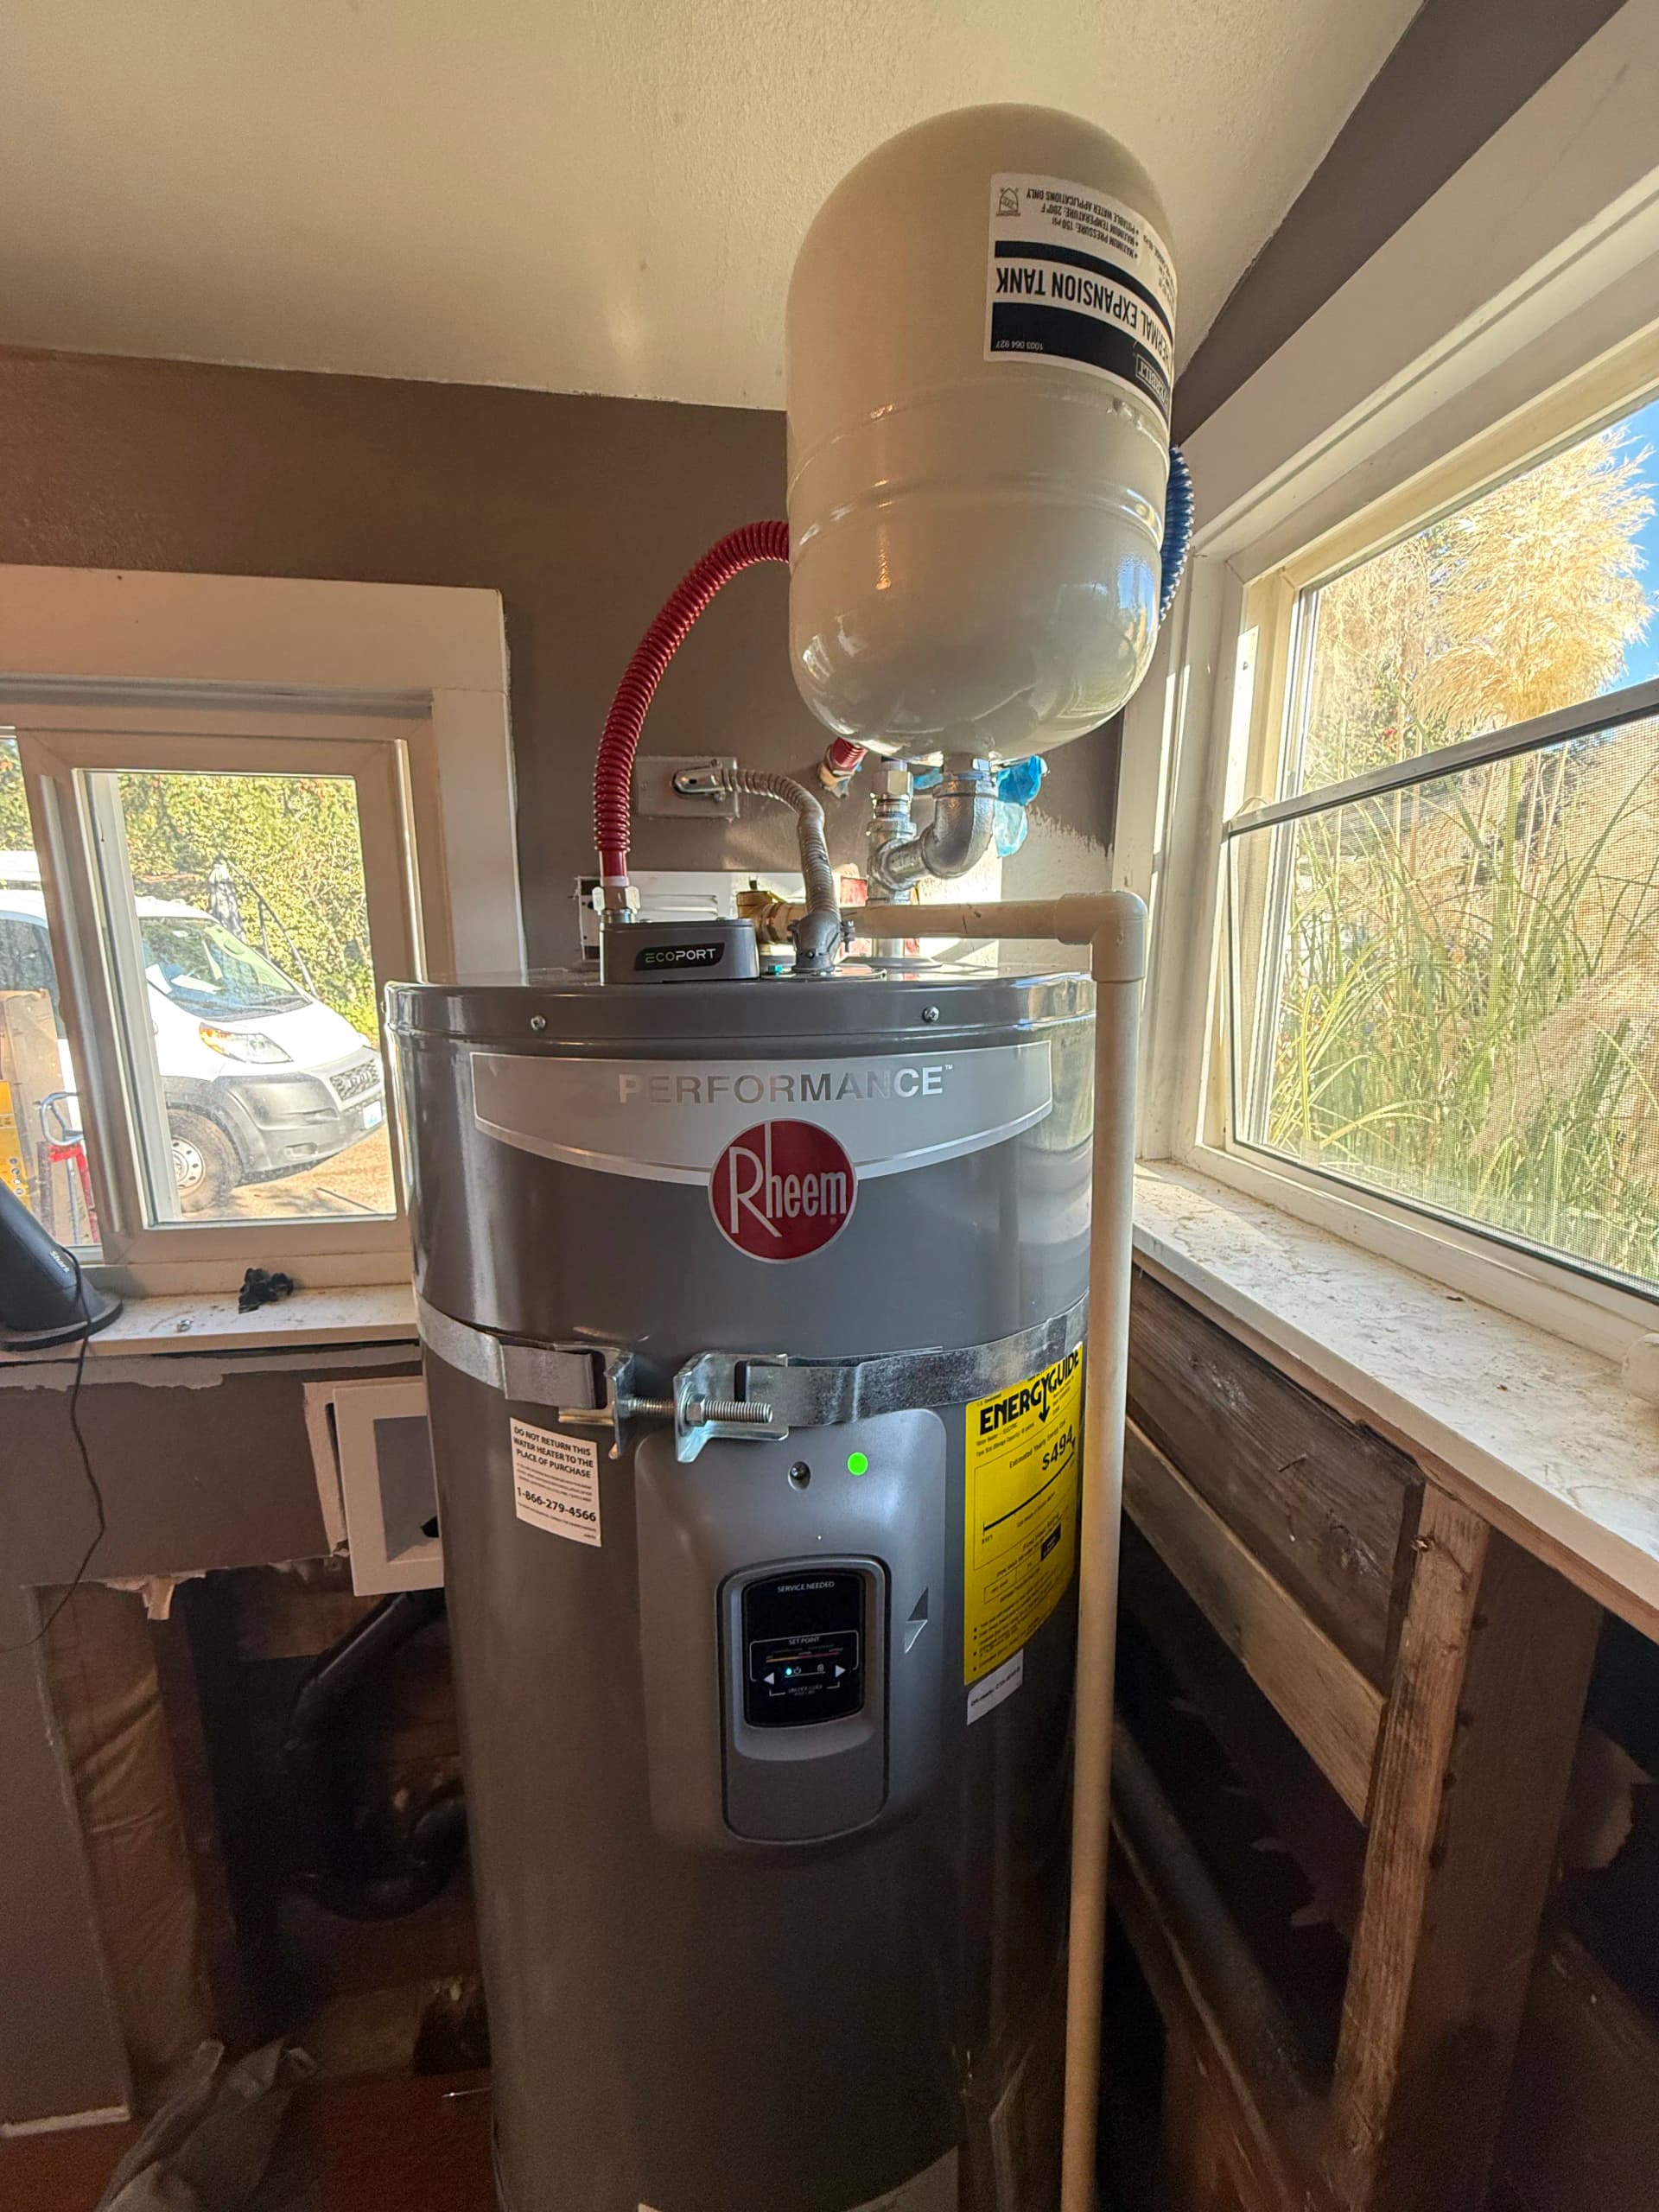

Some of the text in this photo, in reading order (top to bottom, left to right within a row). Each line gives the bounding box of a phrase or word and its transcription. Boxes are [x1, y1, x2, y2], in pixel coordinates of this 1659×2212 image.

[1027, 188, 1046, 200] ONLY
[1046, 191, 1093, 209] APPLICATIONS
[1063, 207, 1109, 231] TEMPERATURE:
[1092, 205, 1112, 217] WATER
[1061, 219, 1074, 231] 150
[1074, 222, 1109, 245] PRESSURE:
[1109, 223, 1135, 245] MAXIMUM
[1109, 238, 1135, 259] MAXIMUM
[995, 267, 1046, 296] TANK
[1052, 272, 1138, 329] EXPANSION
[995, 340, 1010, 349] 927
[1027, 342, 1043, 351] 1003
[645, 949, 716, 963] ECOPORT
[728, 1122, 848, 1237] Rheem
[980, 1350, 1079, 1435] ENERGYGUIDE
[513, 1427, 591, 1456] DO NOT RETURN THIS
[513, 1437, 594, 1468] WATER HEATER TO THE
[516, 1448, 591, 1478] PLACE OF PURCHASE
[517, 1487, 597, 1522] 1-866-279-4566
[777, 1581, 836, 1593] SERVICE NEEDED
